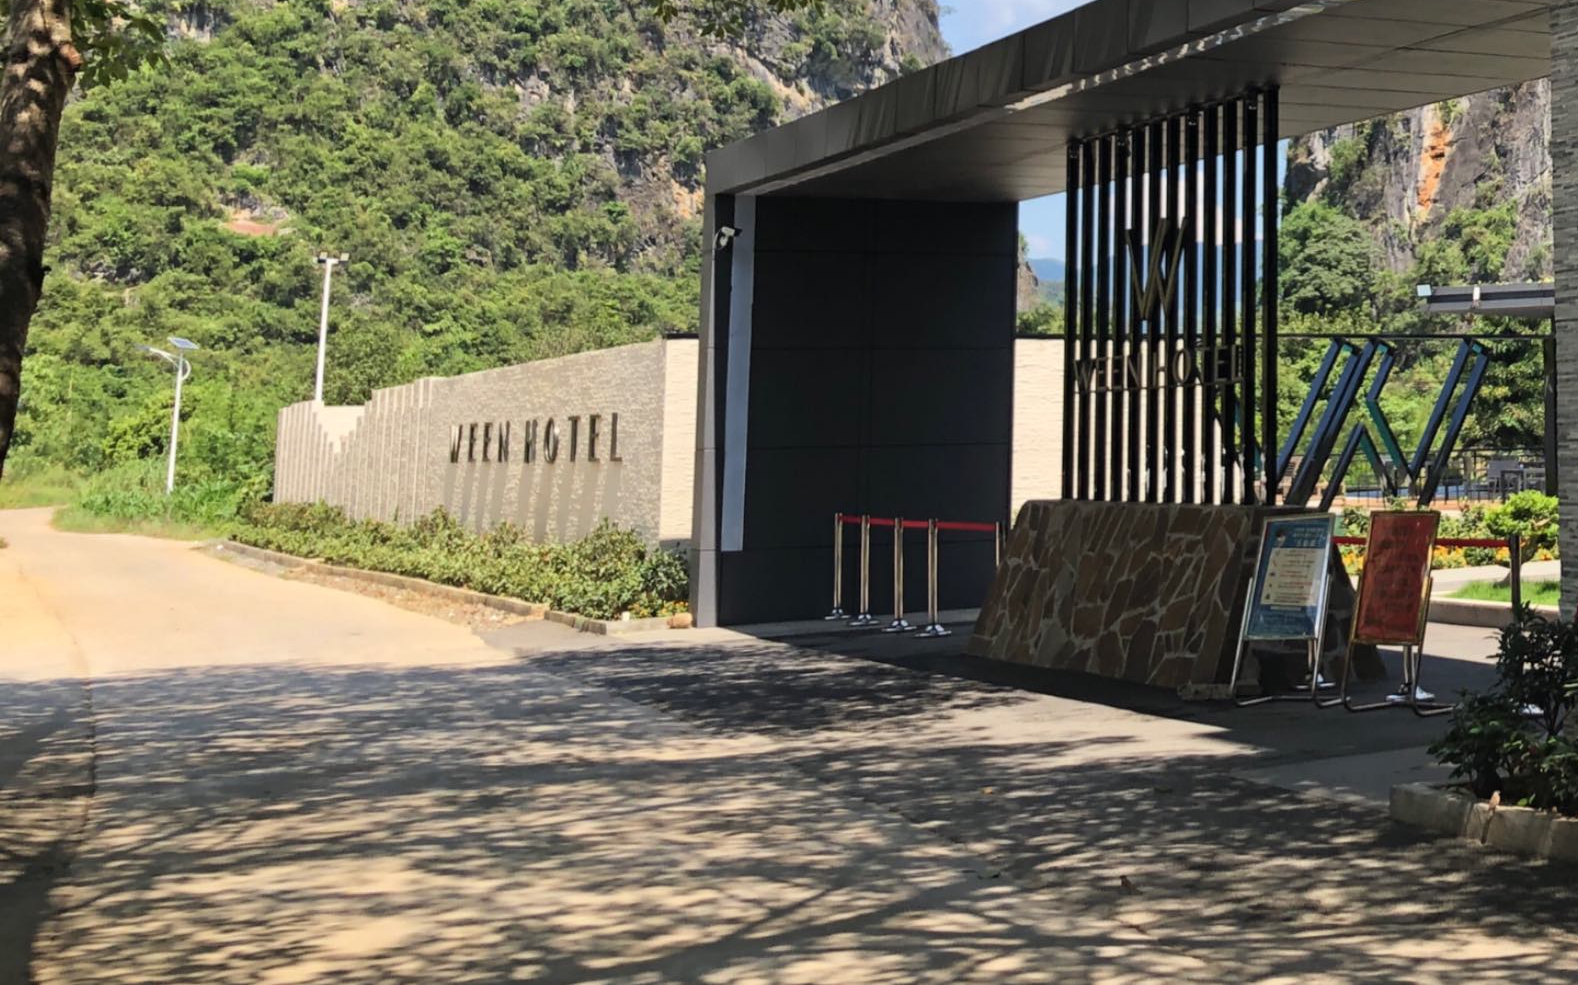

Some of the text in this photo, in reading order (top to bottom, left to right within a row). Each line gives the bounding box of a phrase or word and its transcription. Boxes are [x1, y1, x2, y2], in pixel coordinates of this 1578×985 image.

[1073, 344, 1245, 393] WEEN HOTEL
[450, 412, 623, 464] WEEN HOTEL
